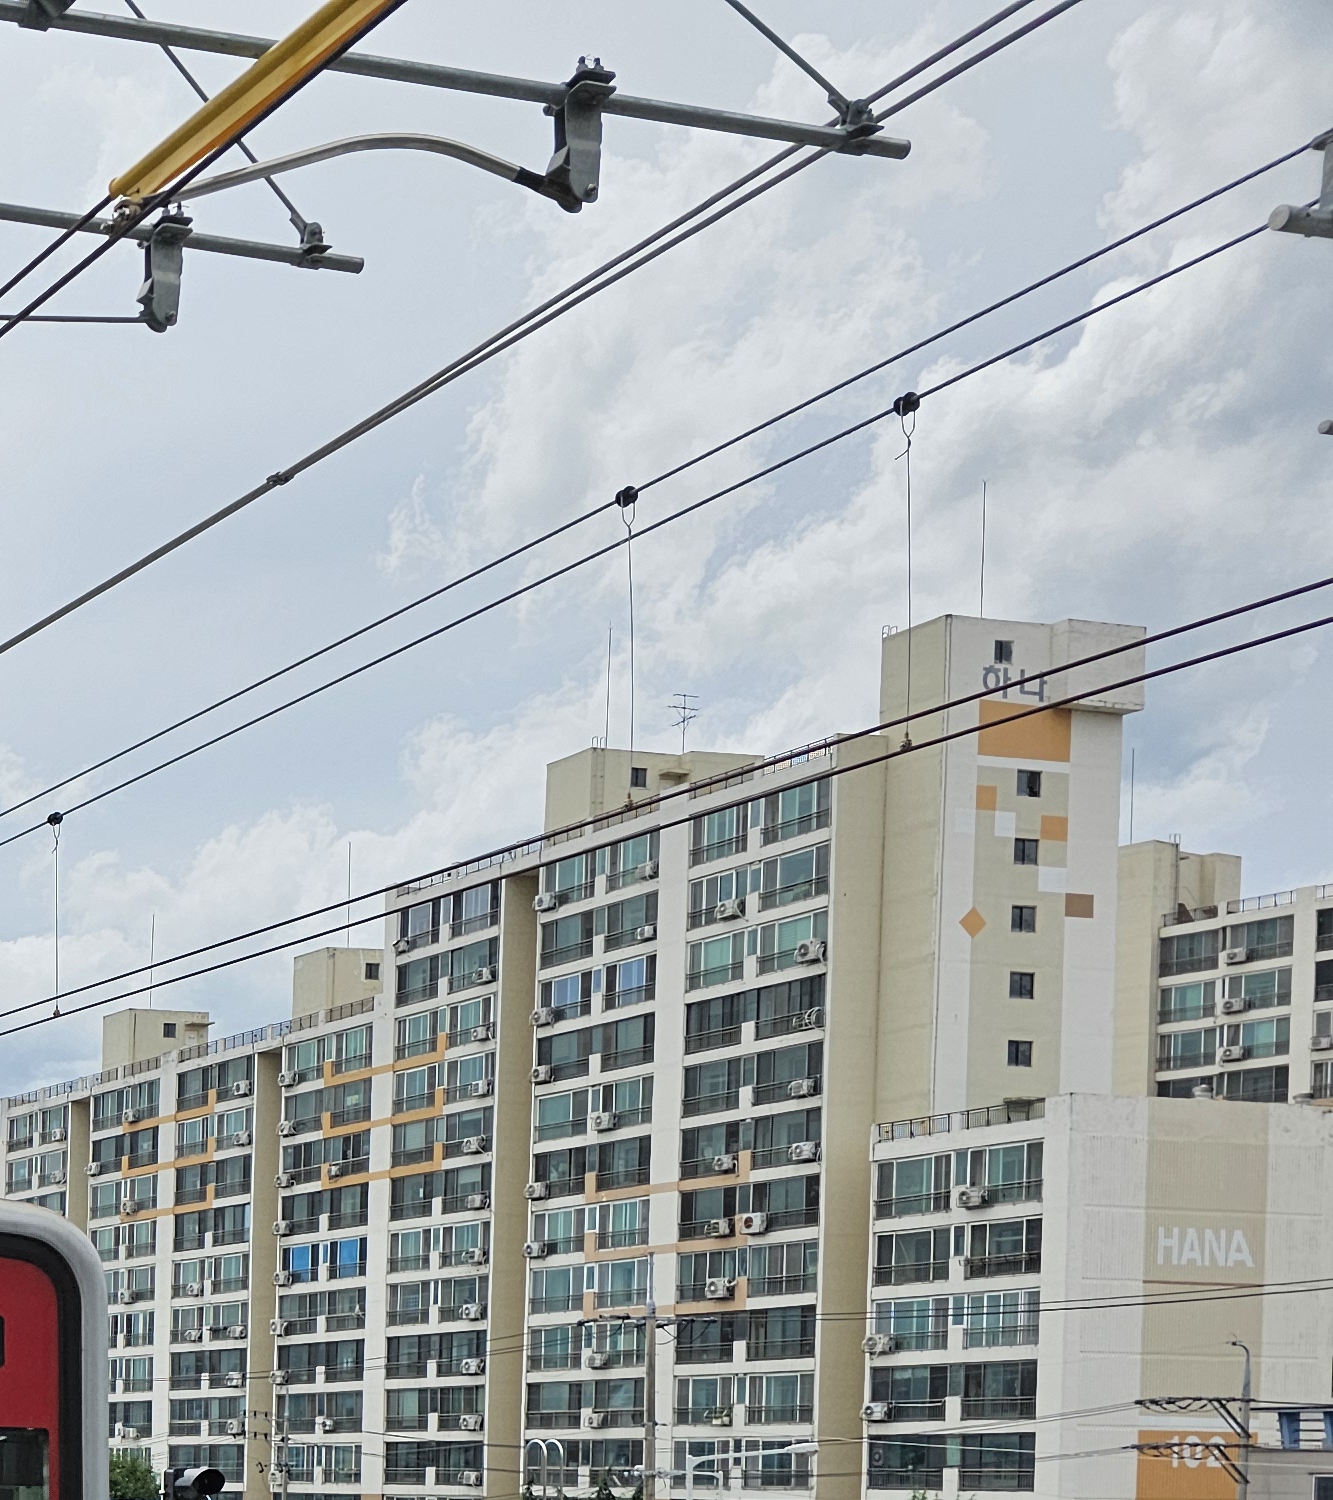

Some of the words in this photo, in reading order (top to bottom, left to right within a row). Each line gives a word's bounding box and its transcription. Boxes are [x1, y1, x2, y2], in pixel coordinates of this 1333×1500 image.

[982, 664, 1048, 702] 하나
[1157, 1226, 1255, 1268] HANA
[1166, 1435, 1226, 1468] 102
